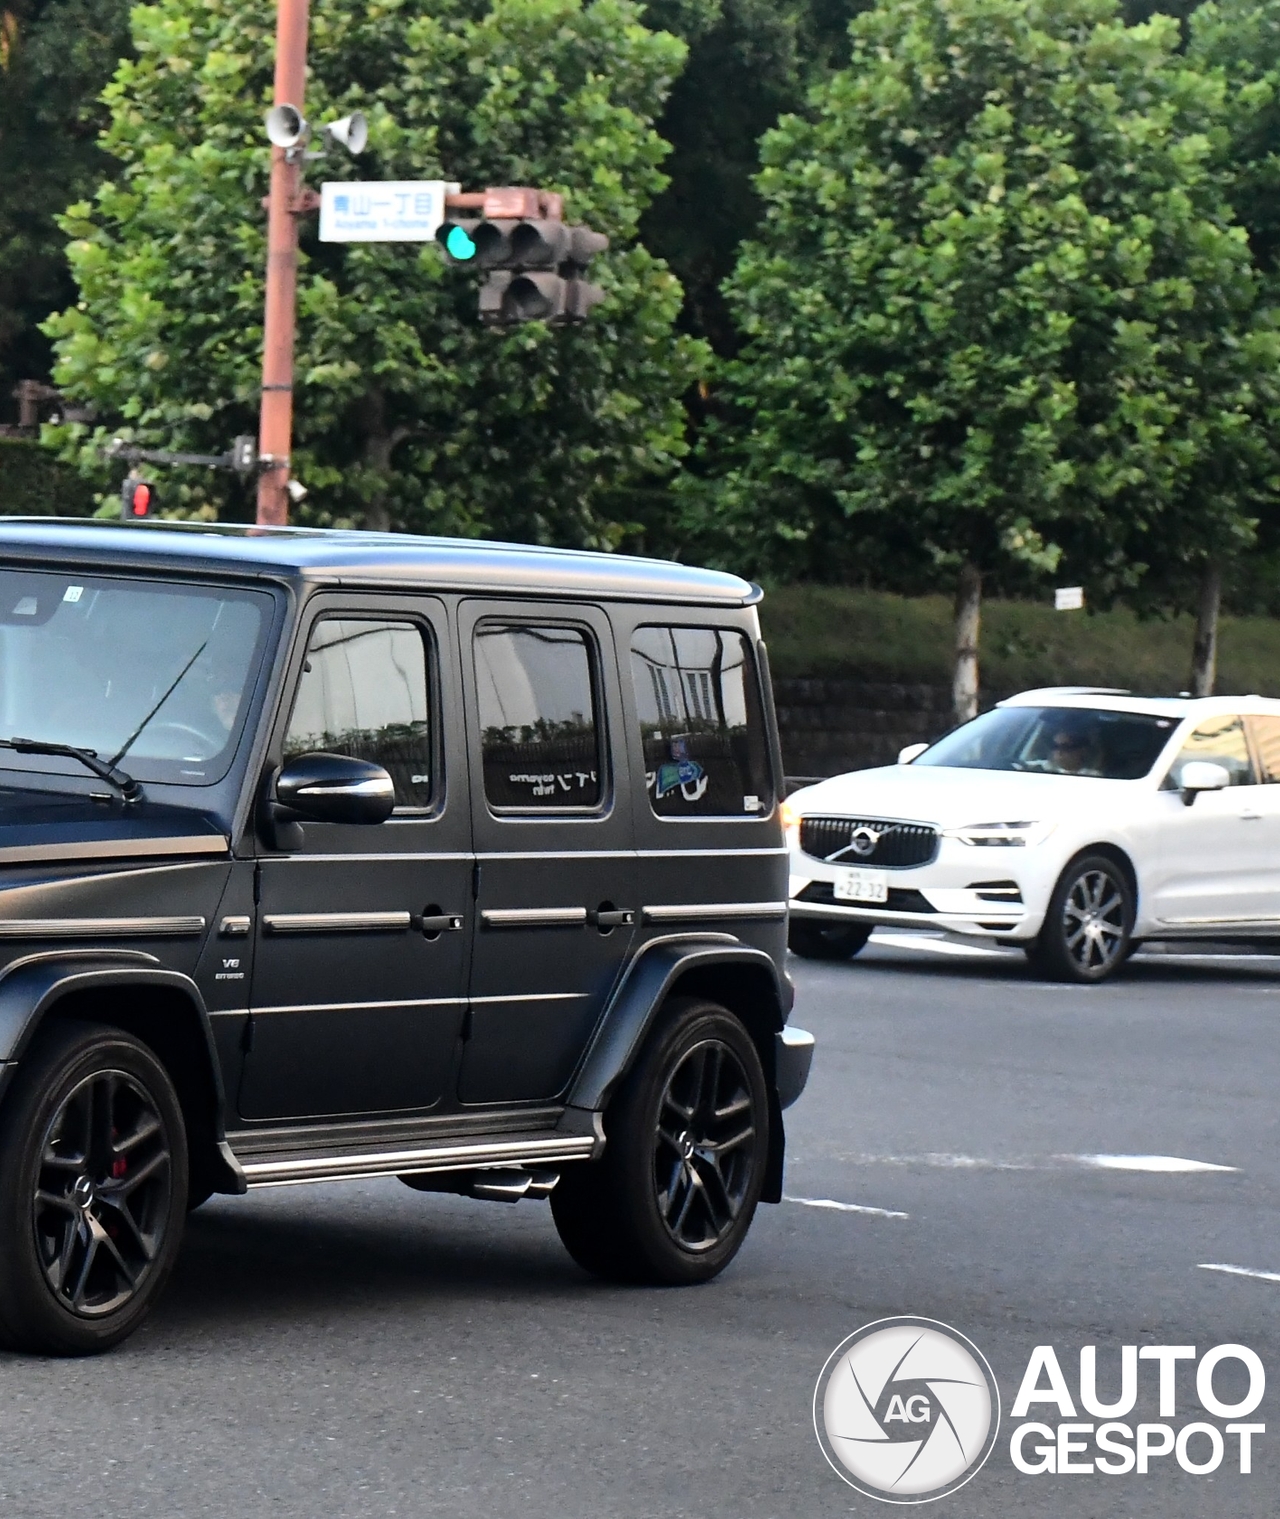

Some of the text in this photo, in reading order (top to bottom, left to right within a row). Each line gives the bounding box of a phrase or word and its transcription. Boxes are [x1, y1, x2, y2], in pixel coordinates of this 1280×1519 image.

[333, 193, 432, 216] 青山一丁目
